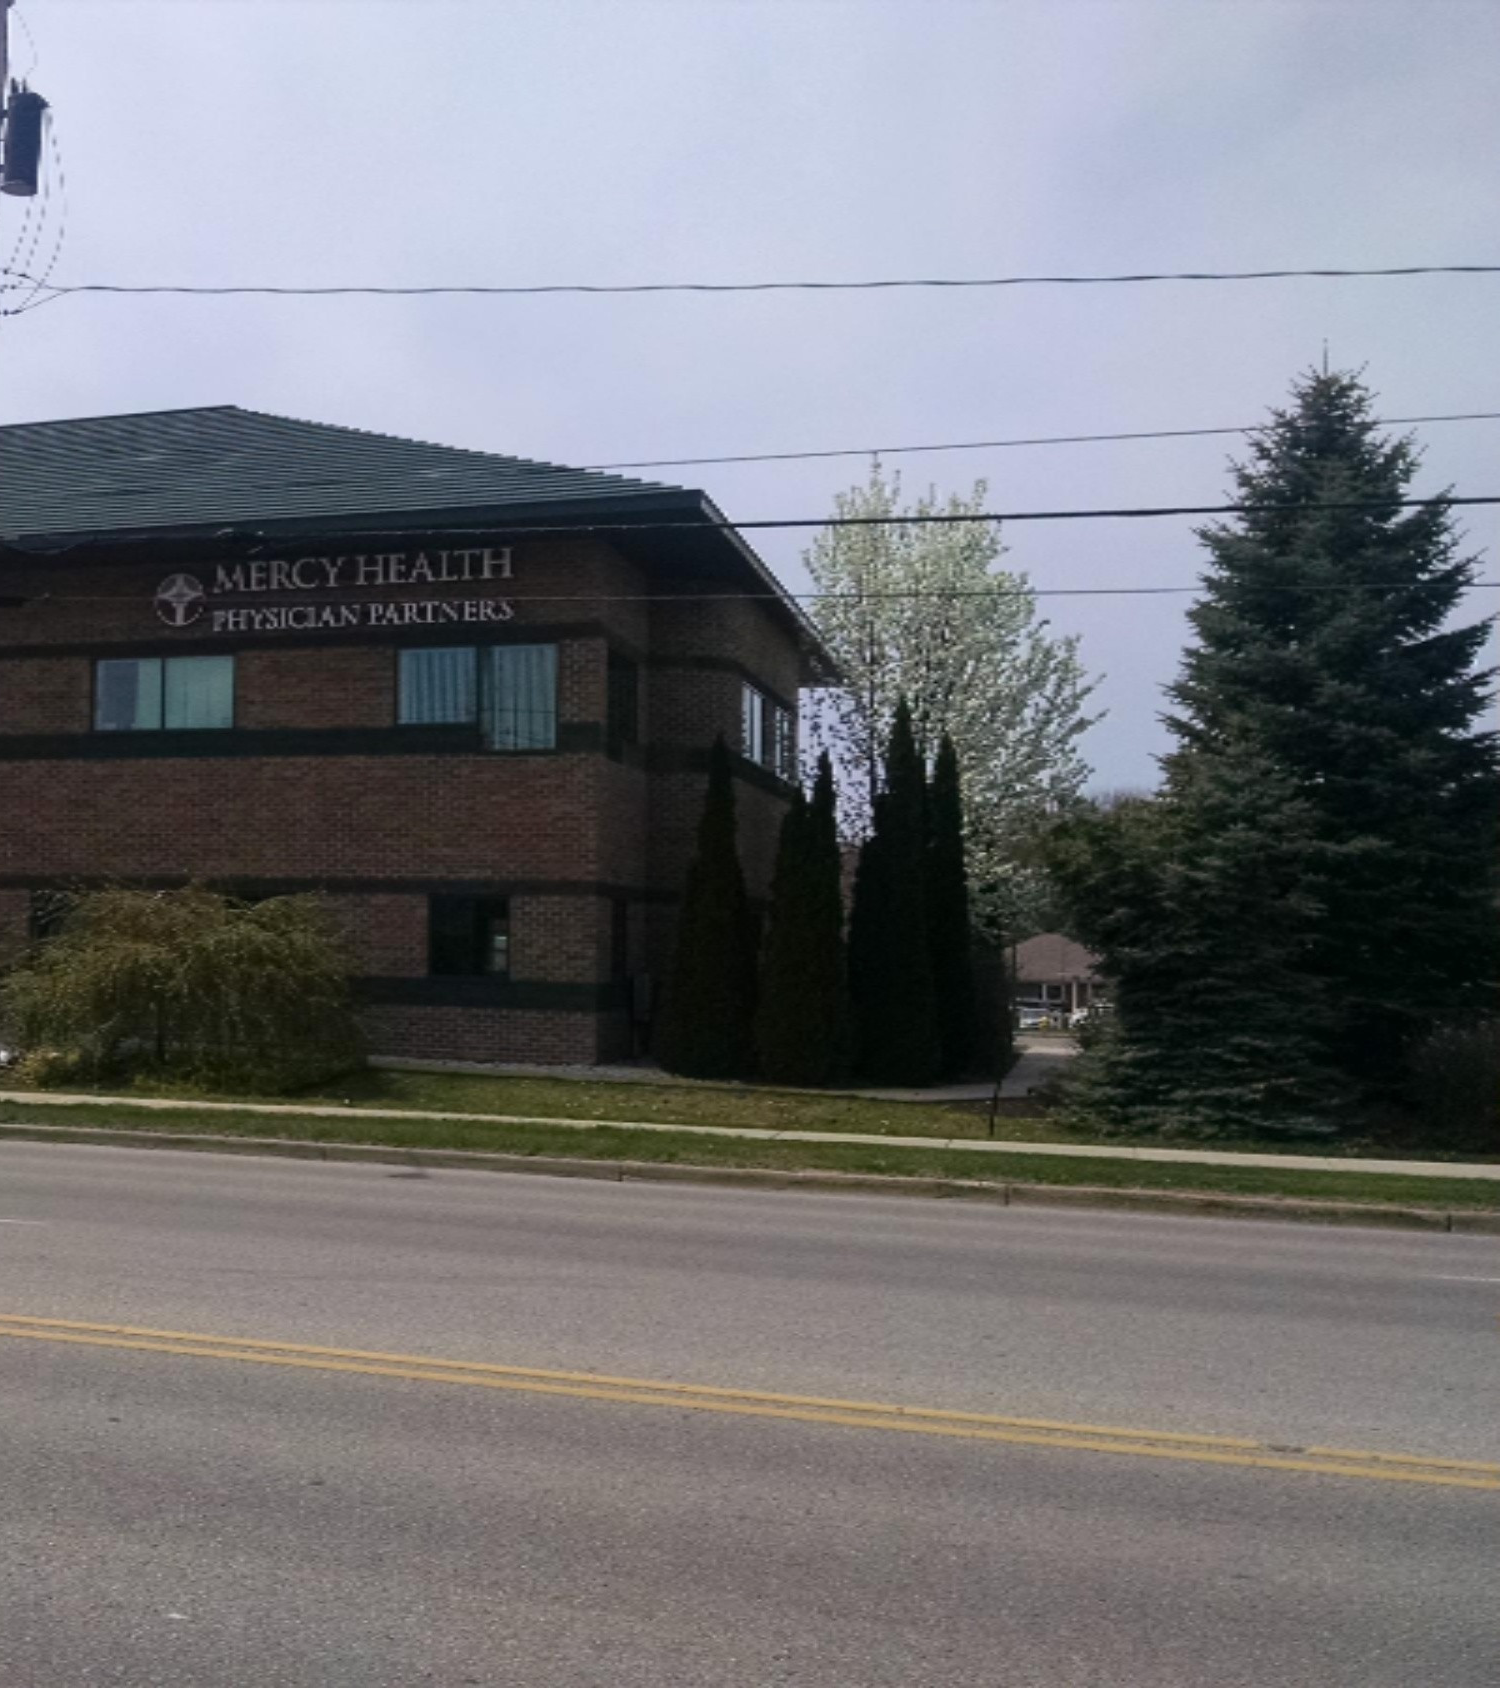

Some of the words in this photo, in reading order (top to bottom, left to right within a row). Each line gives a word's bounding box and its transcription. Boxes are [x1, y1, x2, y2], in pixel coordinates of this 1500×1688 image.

[212, 557, 346, 593] MERCY
[355, 547, 514, 585] HEALTH
[212, 604, 361, 632] PHYSICIAN
[367, 600, 515, 625] PARTNERS
